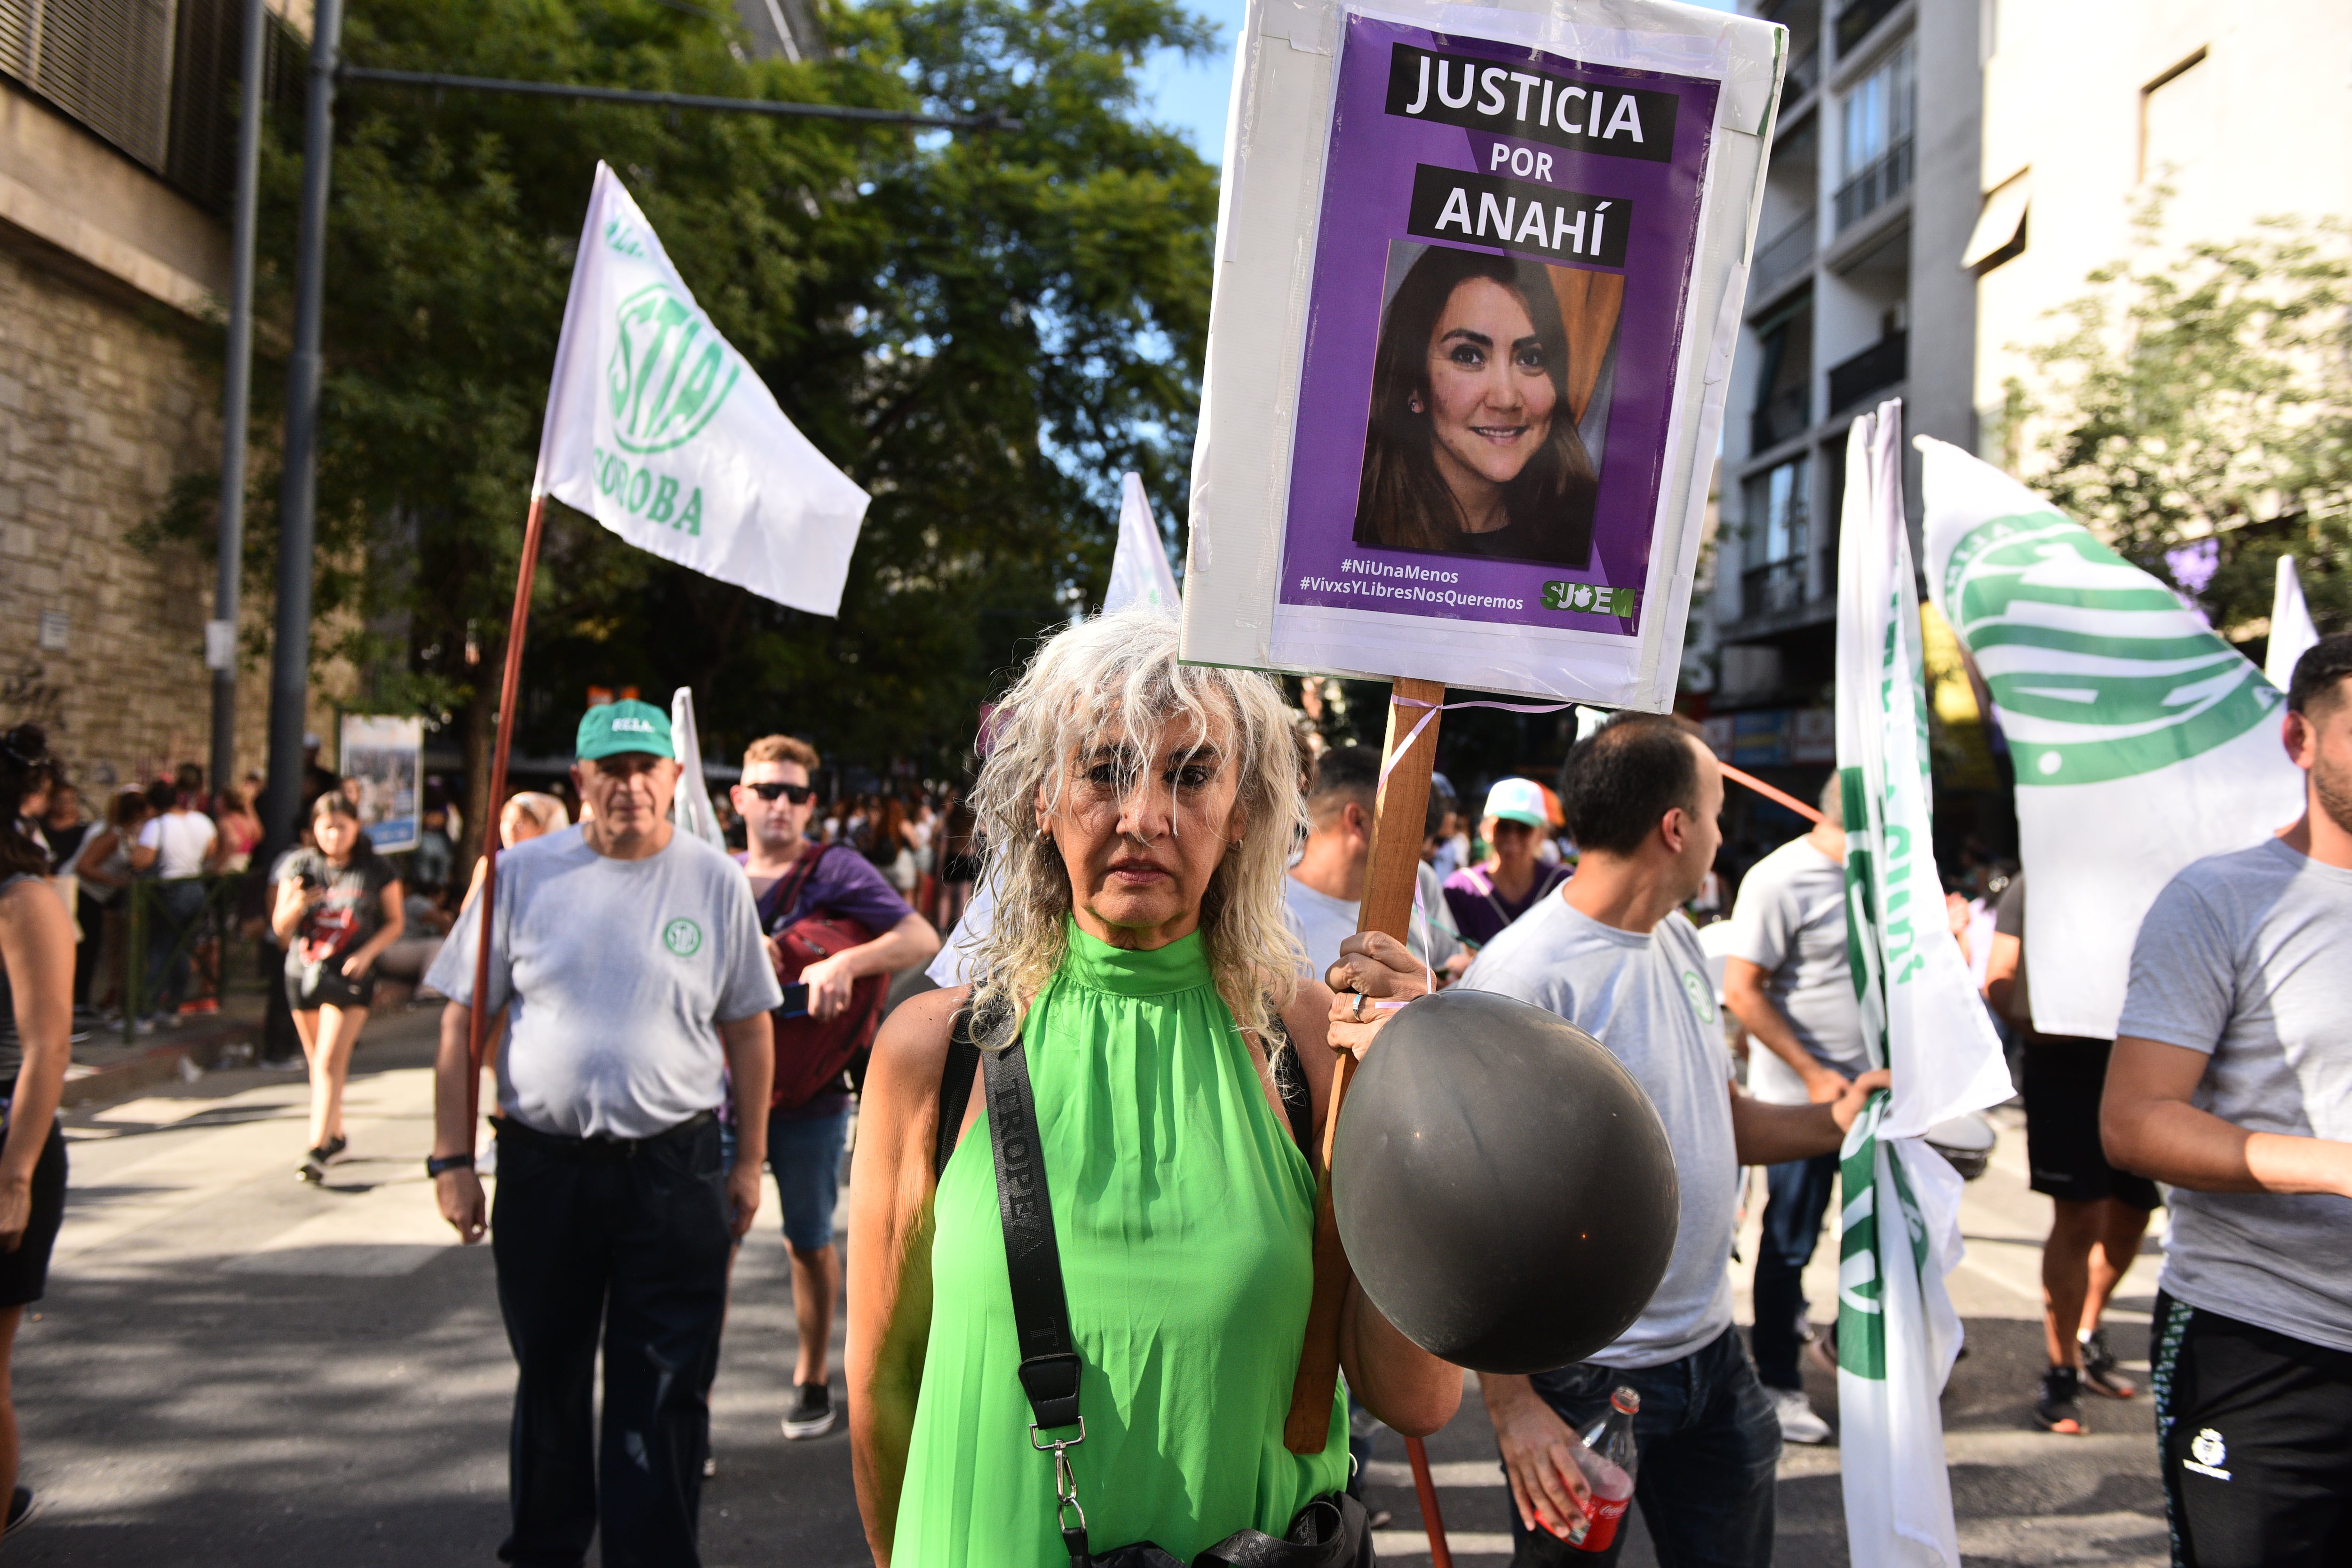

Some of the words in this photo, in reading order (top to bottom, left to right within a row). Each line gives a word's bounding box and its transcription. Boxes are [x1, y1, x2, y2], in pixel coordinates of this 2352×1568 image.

[1406, 55, 1644, 143] JUSTICIA
[1490, 143, 1553, 182] POR
[1434, 187, 1613, 256] ANAHÍ
[1341, 558, 1459, 584] #NiUnaMenos
[1300, 576, 1524, 610] #VivxsYLibresNosQueremos
[1540, 580, 1636, 618] SUOEM
